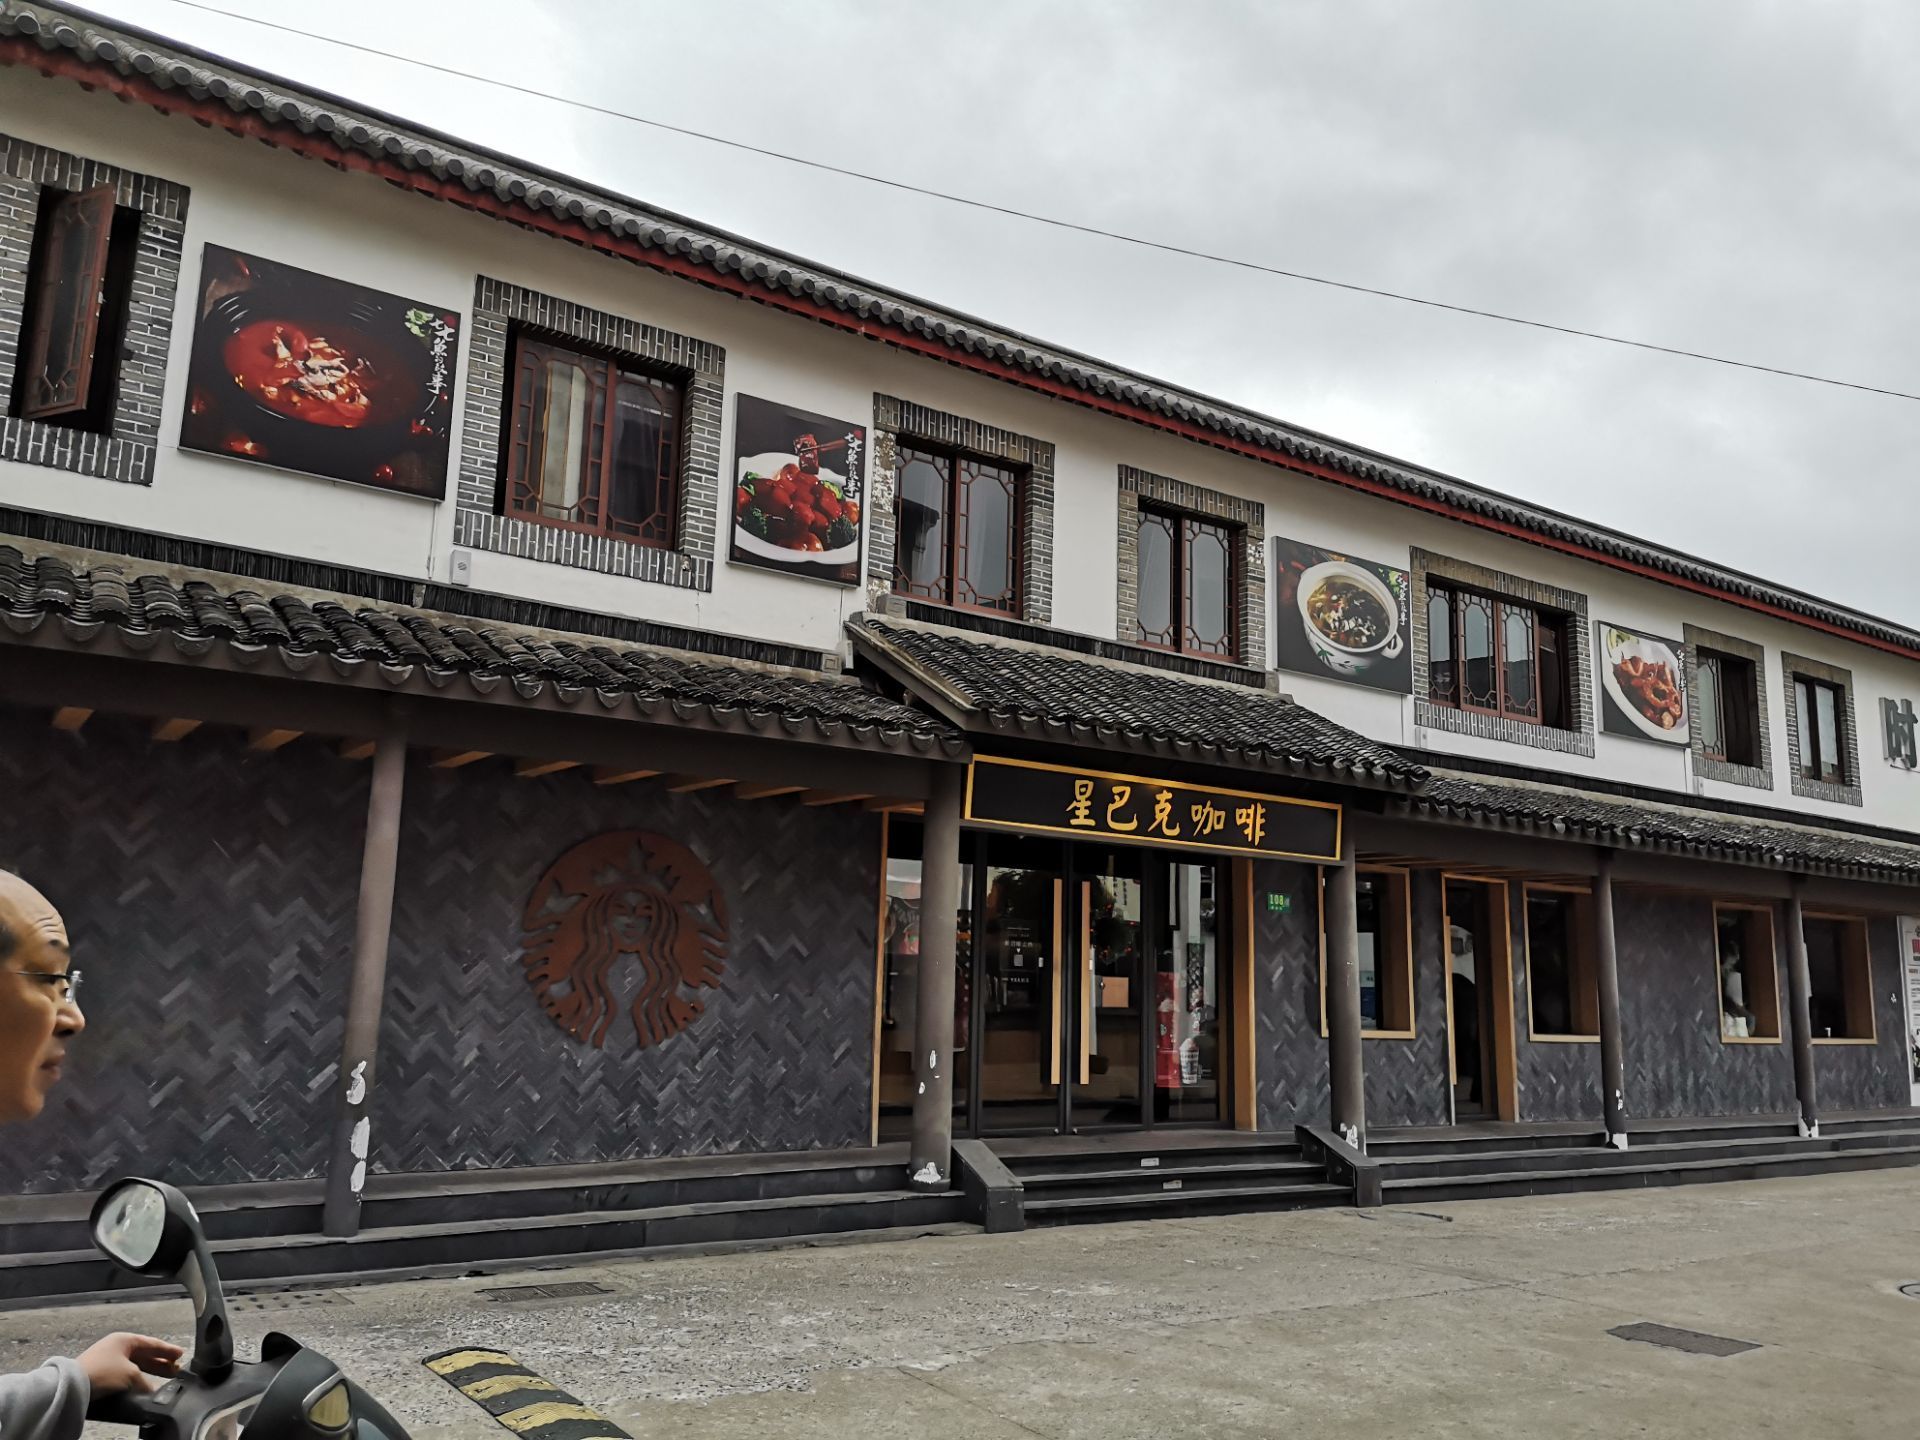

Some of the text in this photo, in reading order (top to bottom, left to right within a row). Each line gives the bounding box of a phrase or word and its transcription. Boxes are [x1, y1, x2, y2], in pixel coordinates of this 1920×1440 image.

[1879, 697, 1918, 769] 时
[1065, 779, 1267, 847] 星巴克咖啡
